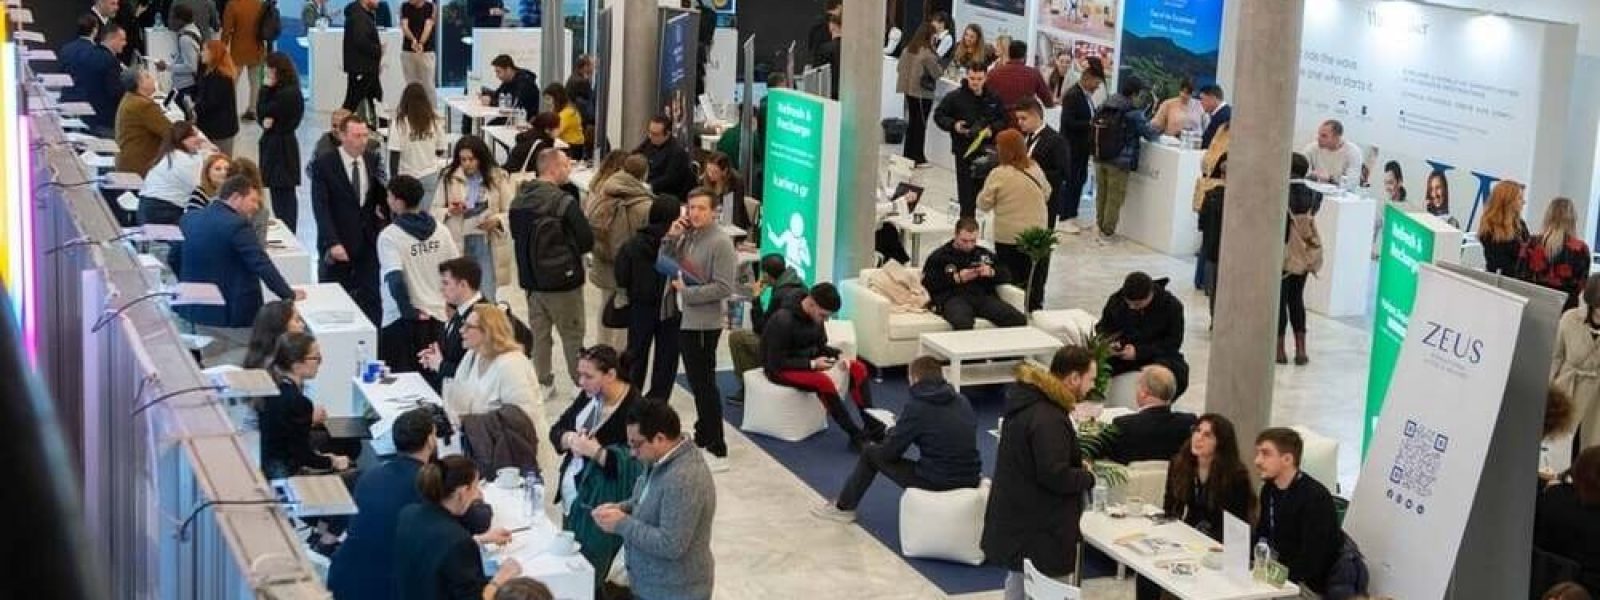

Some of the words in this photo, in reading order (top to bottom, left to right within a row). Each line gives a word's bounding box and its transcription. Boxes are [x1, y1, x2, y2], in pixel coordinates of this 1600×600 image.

[410, 239, 440, 257] STAFF
[1391, 240, 1418, 274] Recharg
[1421, 320, 1484, 364] ZEUS
